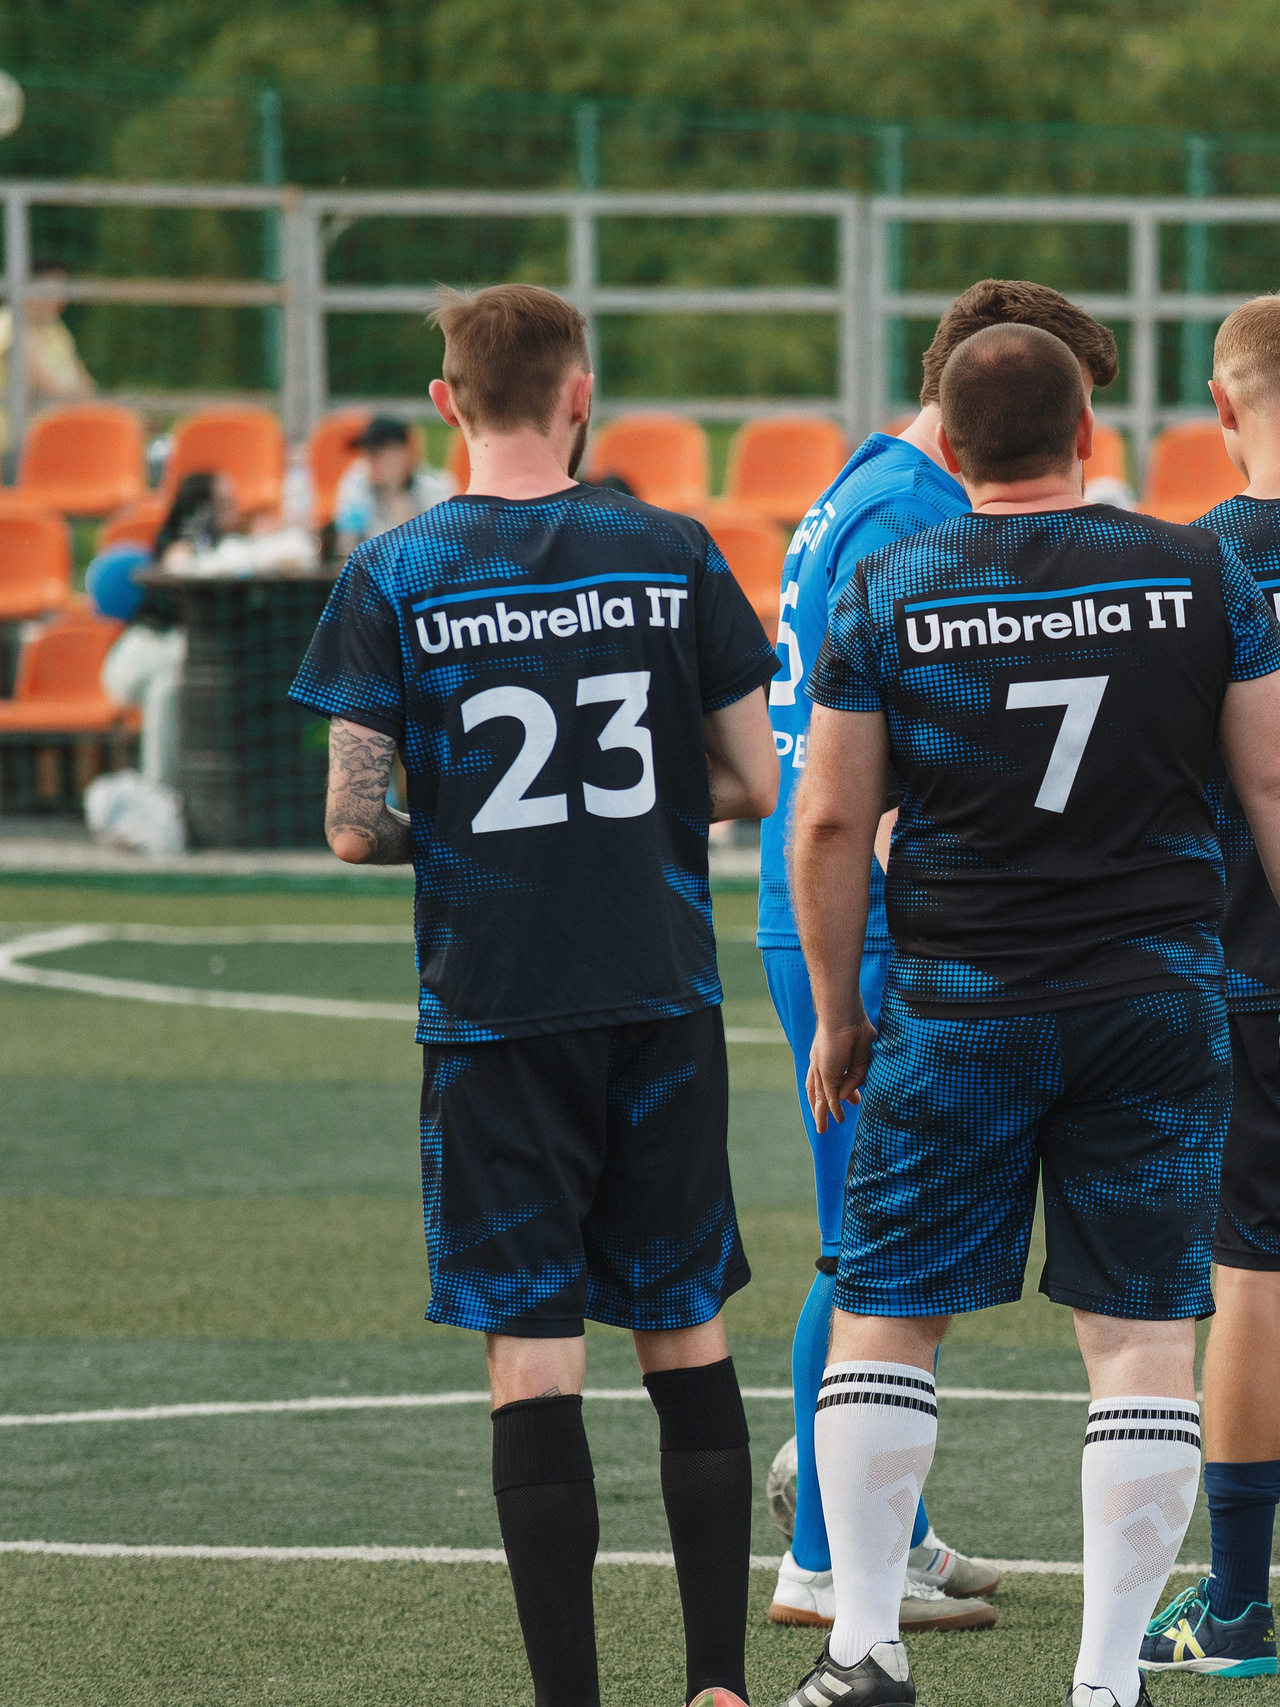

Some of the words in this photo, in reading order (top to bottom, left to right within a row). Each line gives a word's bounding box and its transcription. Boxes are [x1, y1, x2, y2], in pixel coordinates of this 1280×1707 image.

[415, 590, 635, 654] Umbrella
[645, 587, 688, 629] IT
[905, 599, 1132, 654] Umbrella
[1145, 591, 1193, 630] IT
[461, 671, 656, 834] 23
[1005, 675, 1110, 814] 7
